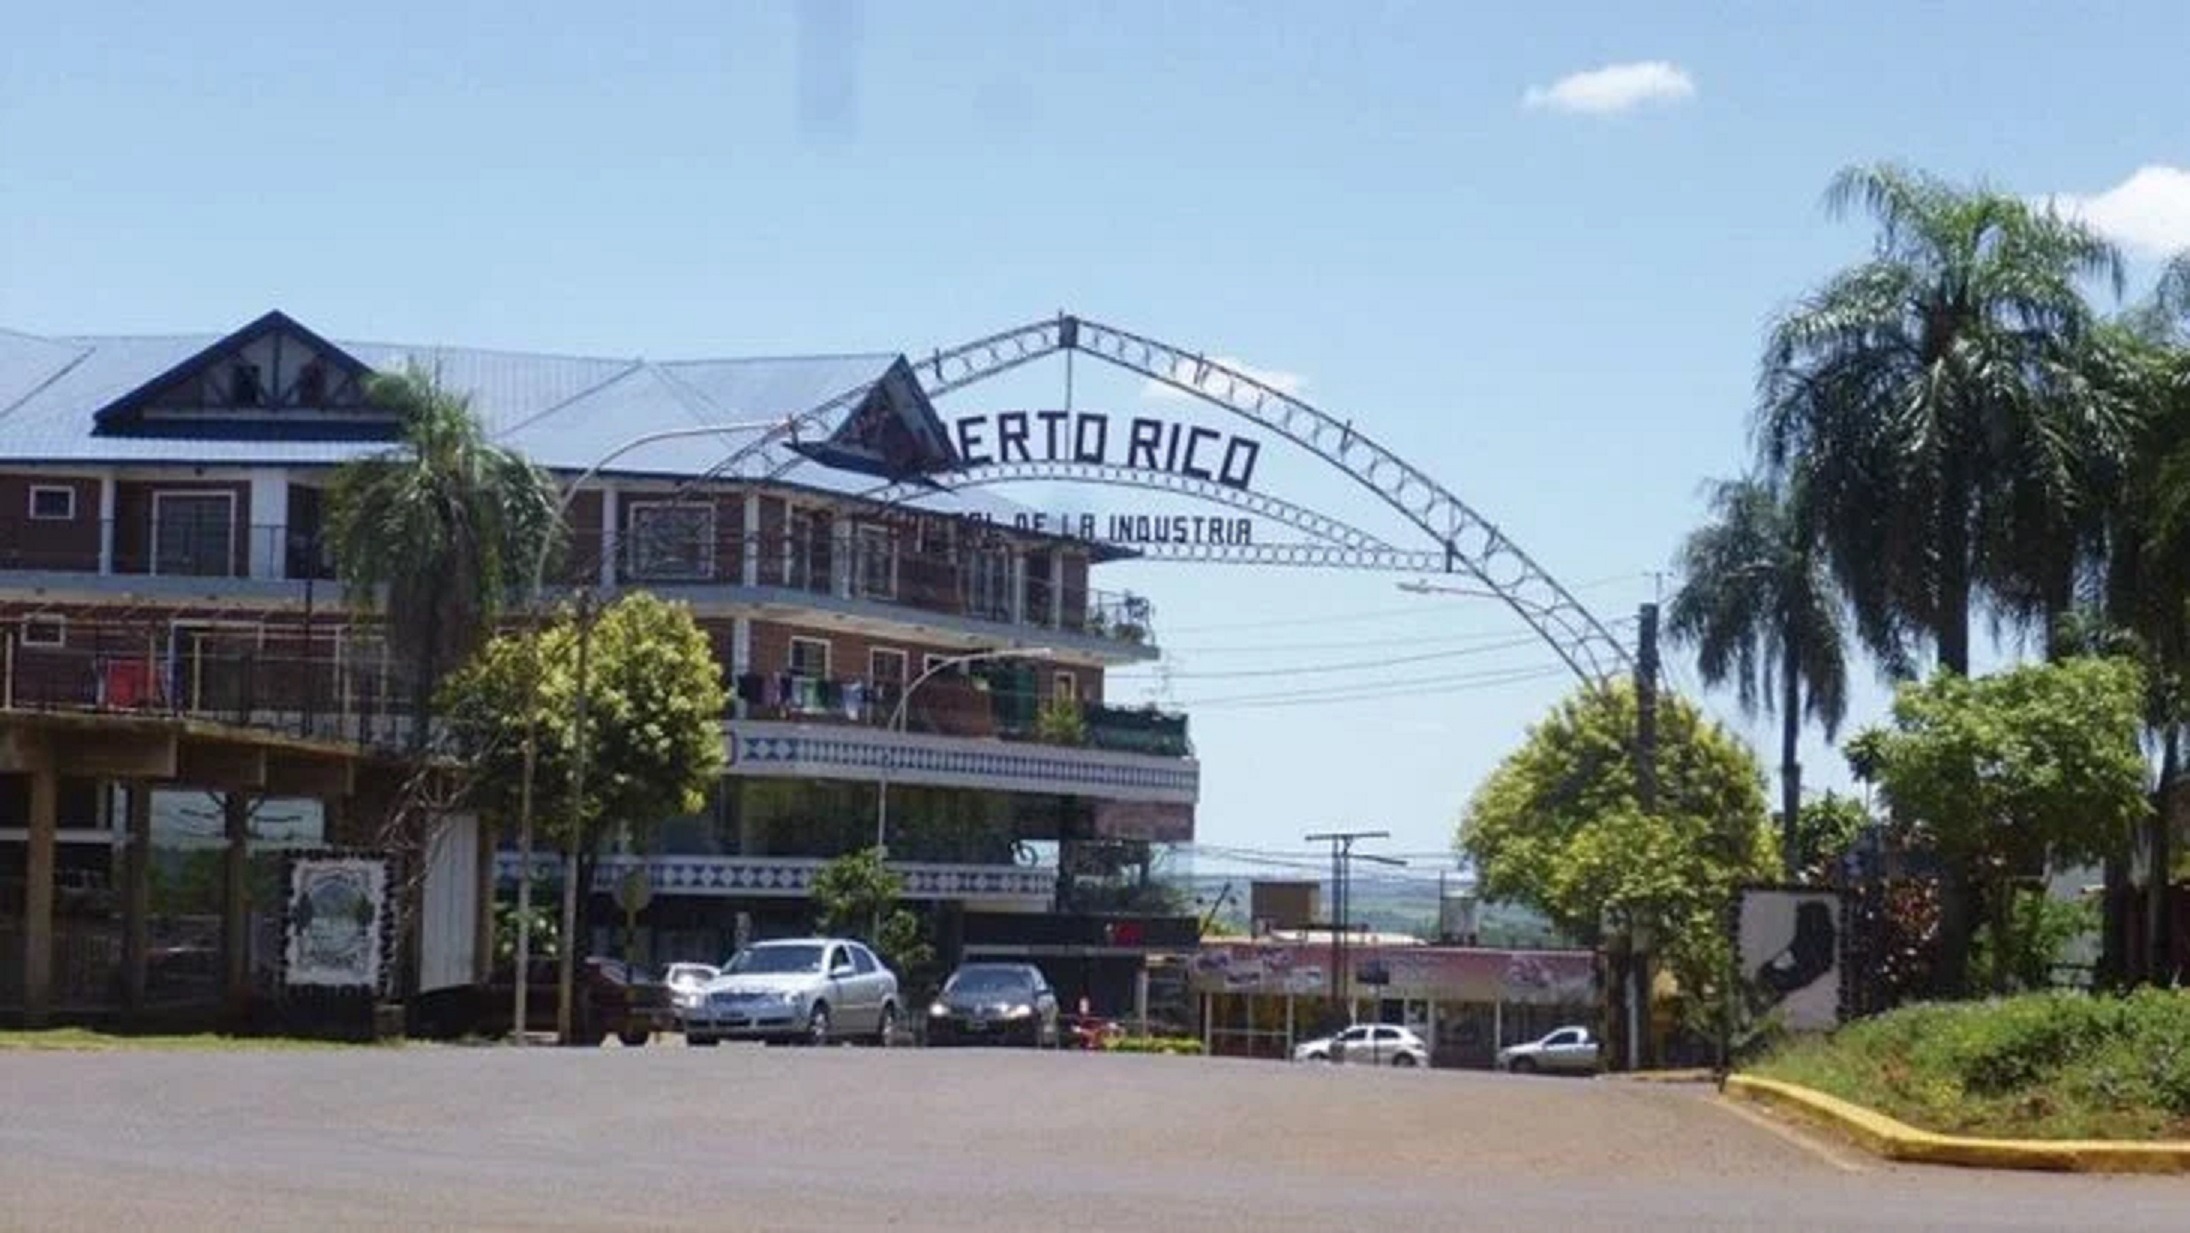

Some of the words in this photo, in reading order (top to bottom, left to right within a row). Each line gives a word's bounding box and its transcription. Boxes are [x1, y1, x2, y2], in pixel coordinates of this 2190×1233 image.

[941, 410, 1107, 467] ERTO
[1128, 417, 1260, 490] RICO
[1109, 514, 1252, 546] INDUSTRIA
